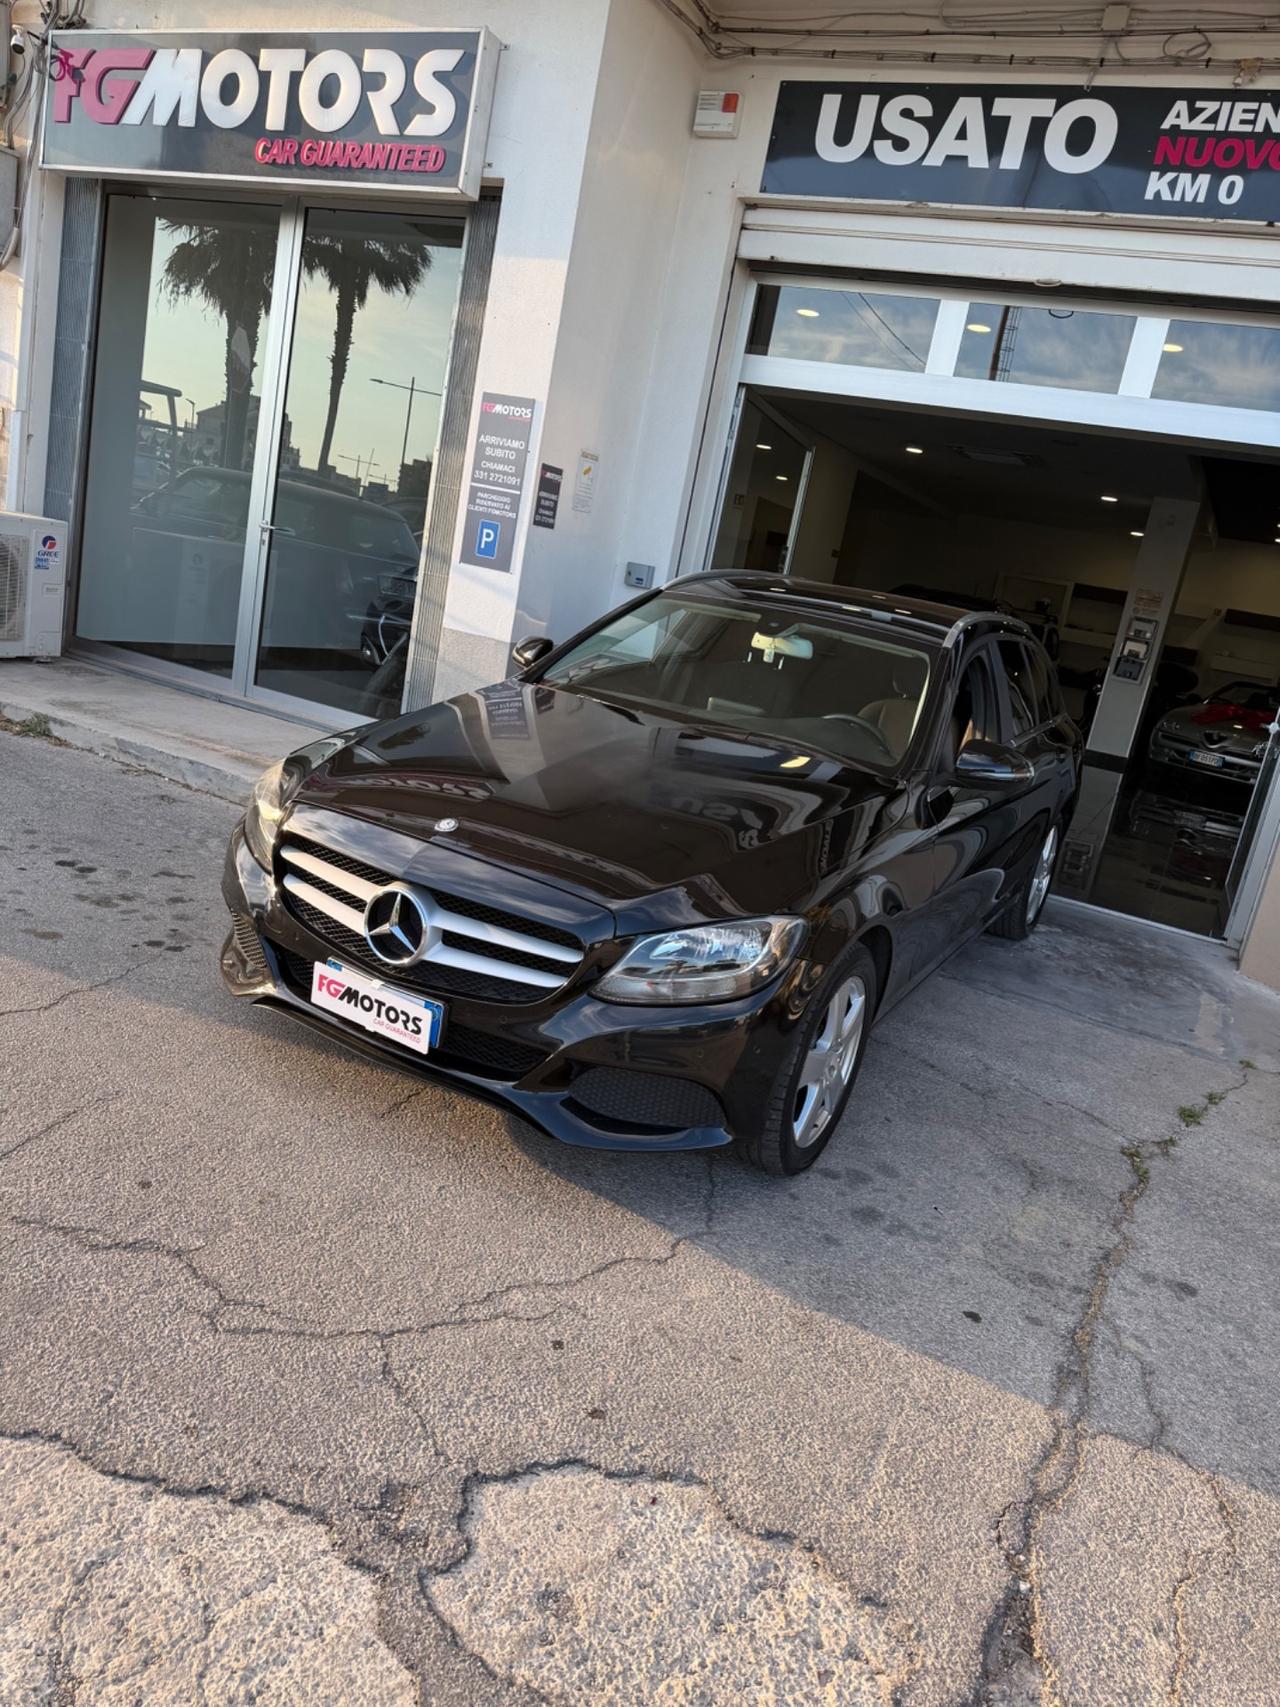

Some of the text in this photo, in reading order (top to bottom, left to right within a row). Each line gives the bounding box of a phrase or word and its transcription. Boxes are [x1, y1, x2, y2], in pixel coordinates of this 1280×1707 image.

[53, 47, 464, 136] FGMOTORS
[814, 93, 1118, 174] USATO
[255, 137, 446, 173] CAR GUARANTEED
[1144, 172, 1243, 205] KM 0
[479, 435, 525, 449] ARRIVIAMO
[485, 448, 516, 460] SUBITO
[481, 460, 516, 473] CHIAMACI
[474, 470, 521, 486] 331 2721091
[480, 528, 494, 549] P
[317, 973, 423, 1036] FGMOTORS
[373, 1017, 385, 1028] CAR
